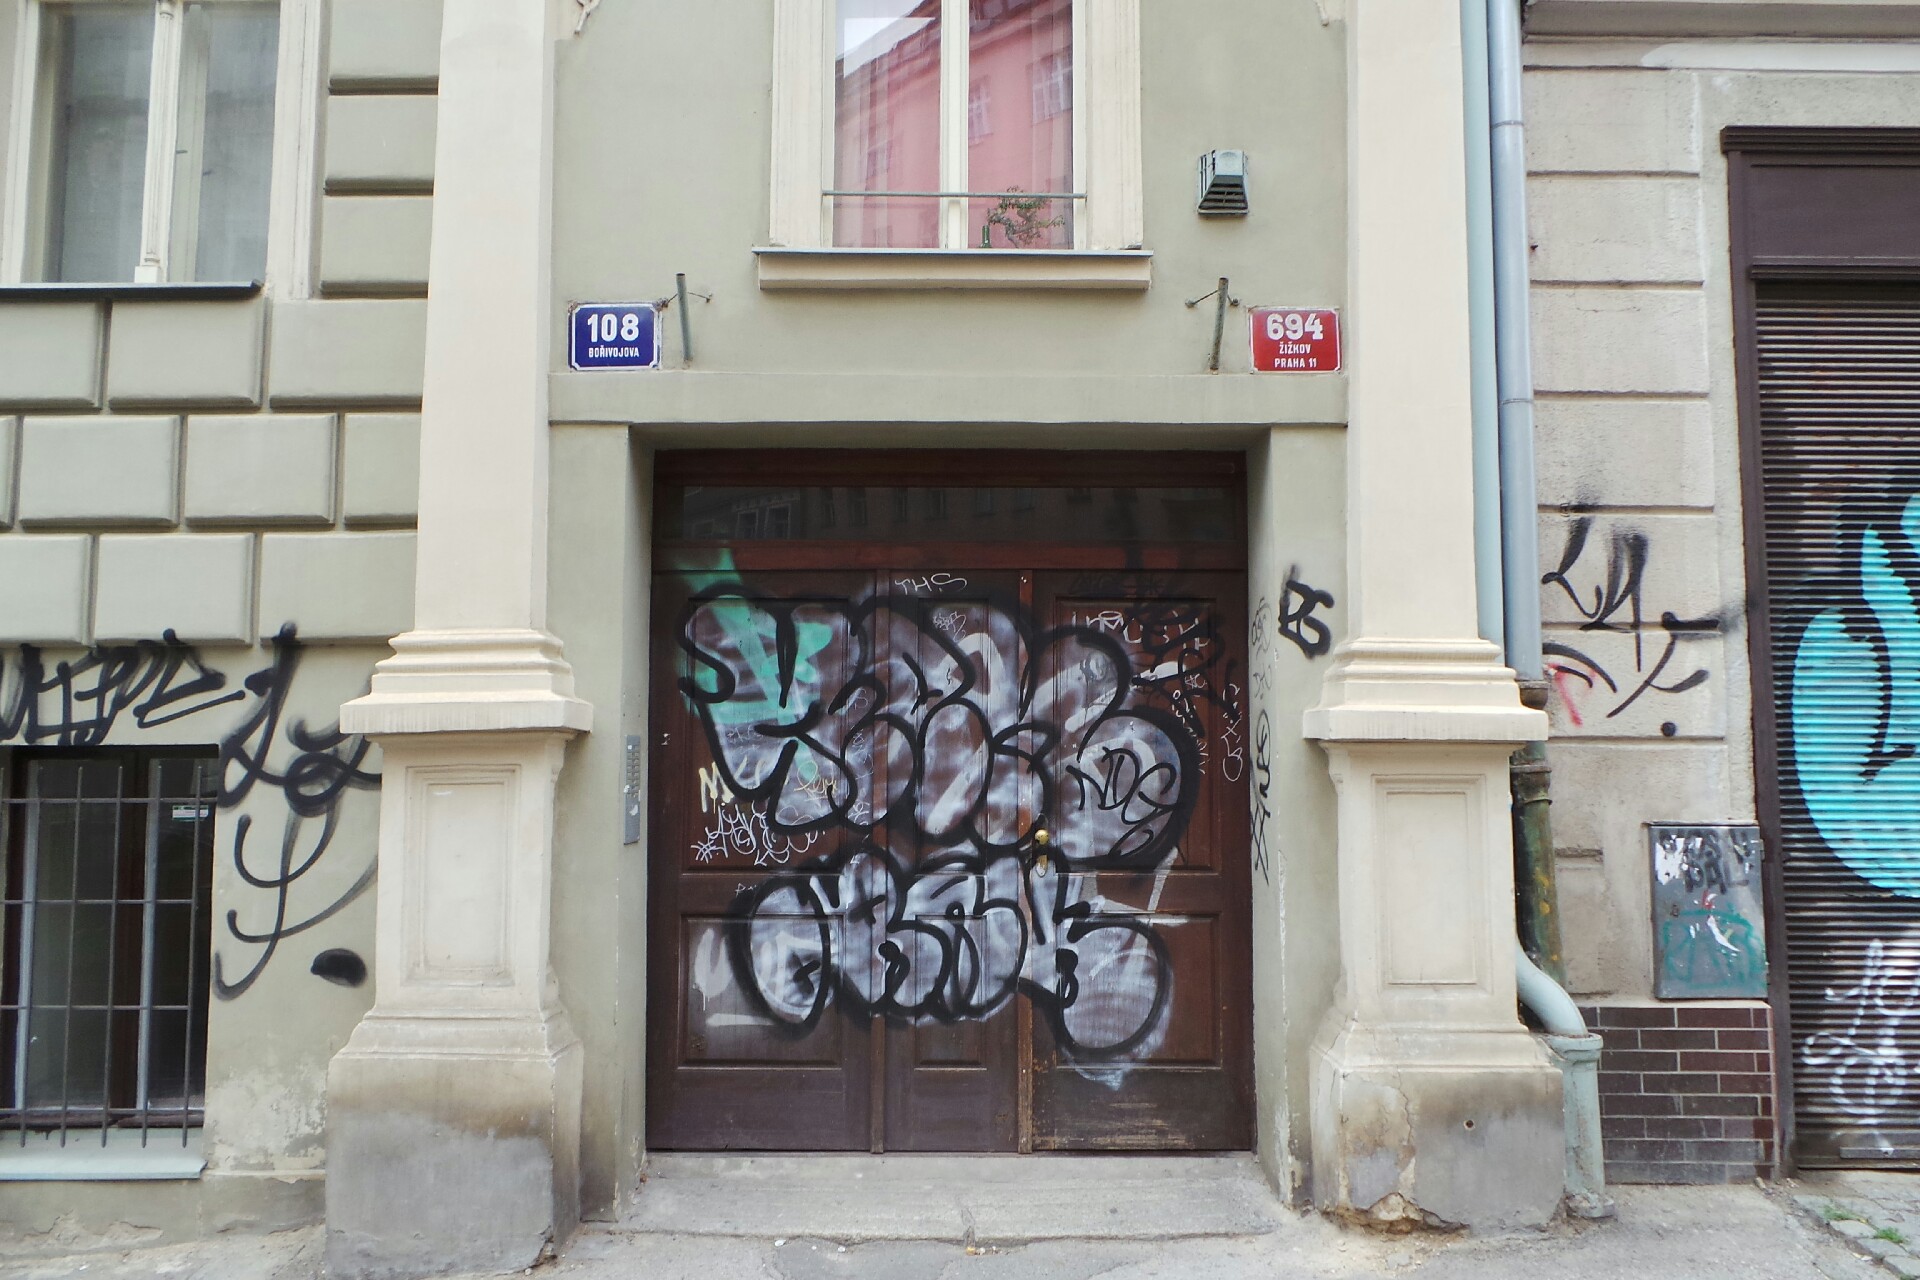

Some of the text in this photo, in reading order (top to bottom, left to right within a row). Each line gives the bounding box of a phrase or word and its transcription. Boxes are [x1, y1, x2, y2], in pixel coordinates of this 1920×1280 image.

[587, 313, 639, 342] 108
[1266, 313, 1323, 340] 694
[588, 345, 639, 358] BOŘIVOJOVA
[1279, 341, 1311, 354] ŽIŽKOV
[1274, 357, 1317, 368] PRAHA 11
